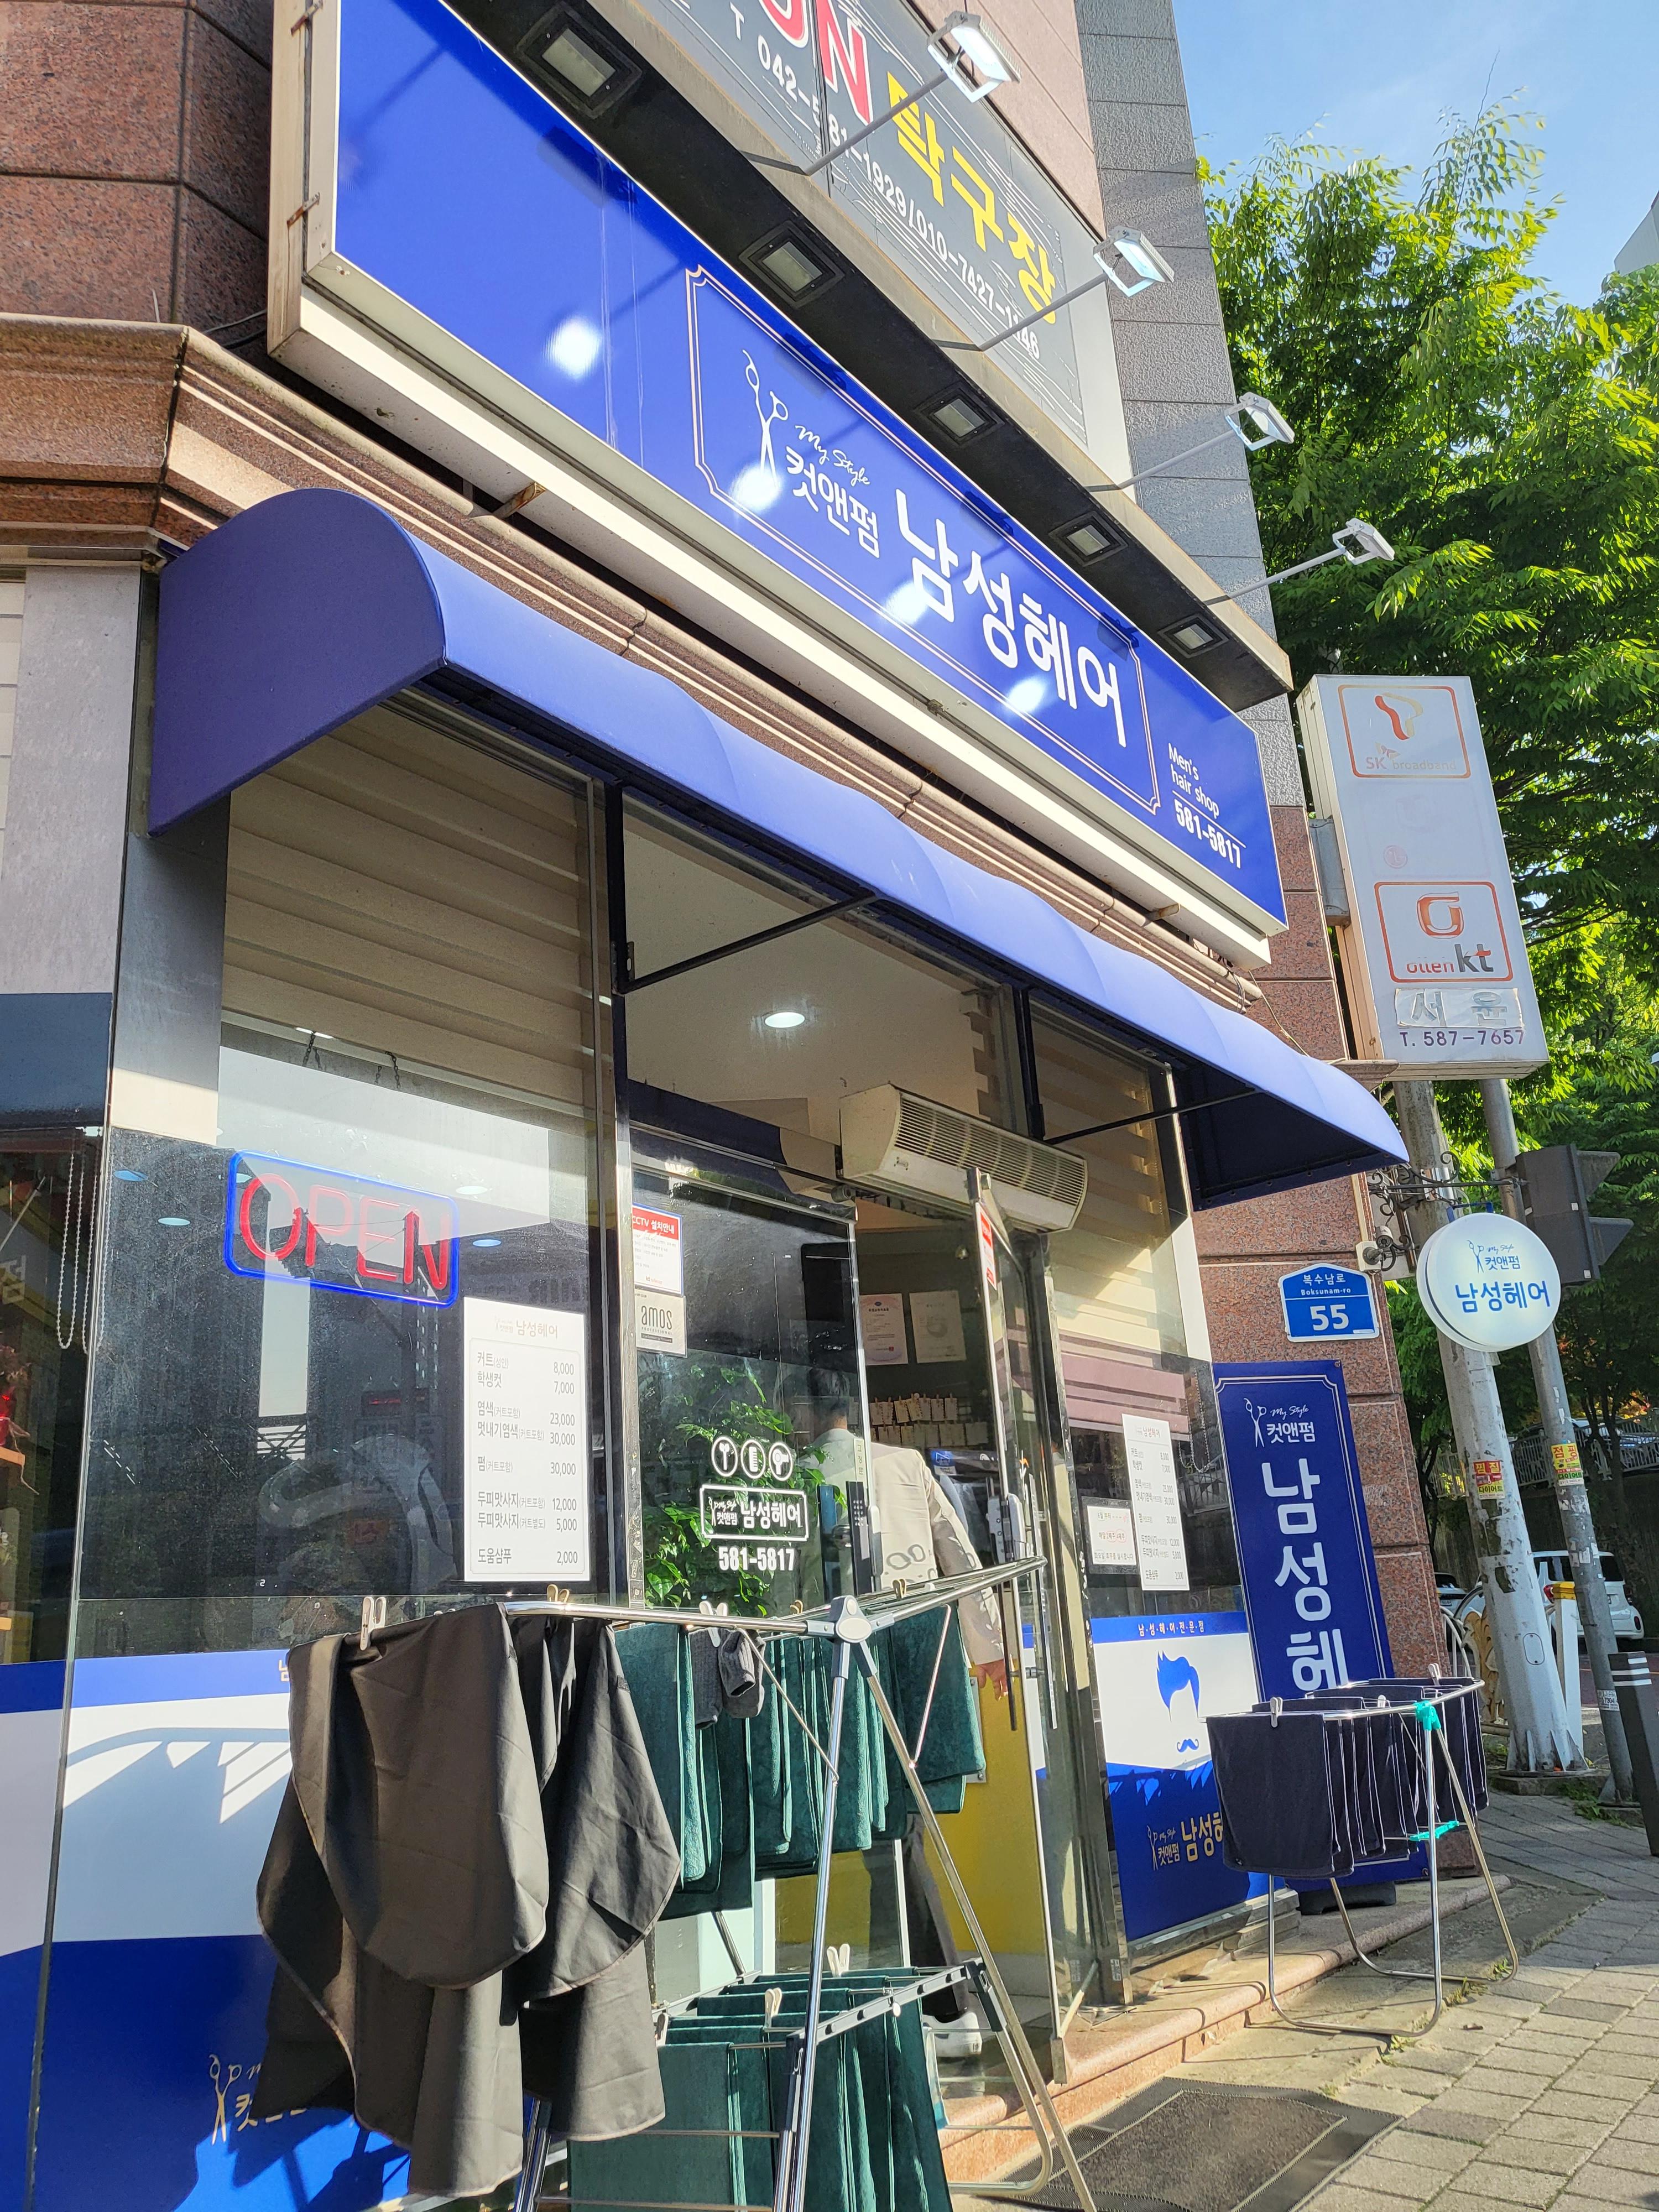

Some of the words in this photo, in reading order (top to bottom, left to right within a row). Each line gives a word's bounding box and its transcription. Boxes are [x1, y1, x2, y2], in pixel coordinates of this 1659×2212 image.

[888, 71, 1056, 324] 탁구장
[795, 425, 830, 465] My
[832, 450, 870, 487] Style
[786, 446, 880, 559] 컷앤펌
[895, 489, 1127, 748] 남성헤어
[1168, 743, 1199, 781] Men's
[1365, 757, 1387, 770] SK
[1170, 764, 1192, 795] hair
[1195, 786, 1220, 820] shop
[1174, 799, 1241, 869] 581-5817
[1423, 1030, 1525, 1047] 587-7657
[239, 1173, 450, 1290] OPEN
[651, 1220, 675, 1235] 설치안내
[1484, 1255, 1521, 1270] 컷앤펌
[1303, 1273, 1347, 1286] 복수남로
[1455, 1280, 1551, 1313] 남성헤어
[641, 1305, 672, 1329] amos
[1310, 1304, 1349, 1331] 55
[516, 1320, 558, 1339] 남성헤어
[477, 1352, 509, 1369] 커트(성인)
[554, 1361, 575, 1375] 8,000
[477, 1371, 502, 1388] 학생컷
[554, 1381, 575, 1395] 7,000
[477, 1400, 520, 1419] 염색(커트포함)
[550, 1412, 575, 1426] 23,000
[1270, 1407, 1287, 1420] My
[1289, 1404, 1310, 1418] Style
[477, 1421, 544, 1441] 멋내기염색(커트포함)
[550, 1432, 576, 1446] 30,000
[1266, 1421, 1316, 1443] 컷앤펌
[477, 1455, 513, 1473] 펌(커트포함)
[550, 1462, 576, 1475] 30,000
[477, 1491, 545, 1509] 두피맛사지(커트포함)
[552, 1498, 577, 1511] 12,000
[556, 1518, 577, 1532] 5,000
[717, 1512, 738, 1526] 컷앤펌
[740, 1500, 801, 1530] 남성헤어
[477, 1547, 512, 1564] 도움샴푸
[557, 1551, 578, 1566] 2,000
[719, 1546, 795, 1571] 581-5817
[1157, 1842, 1180, 1866] 컷앤펌
